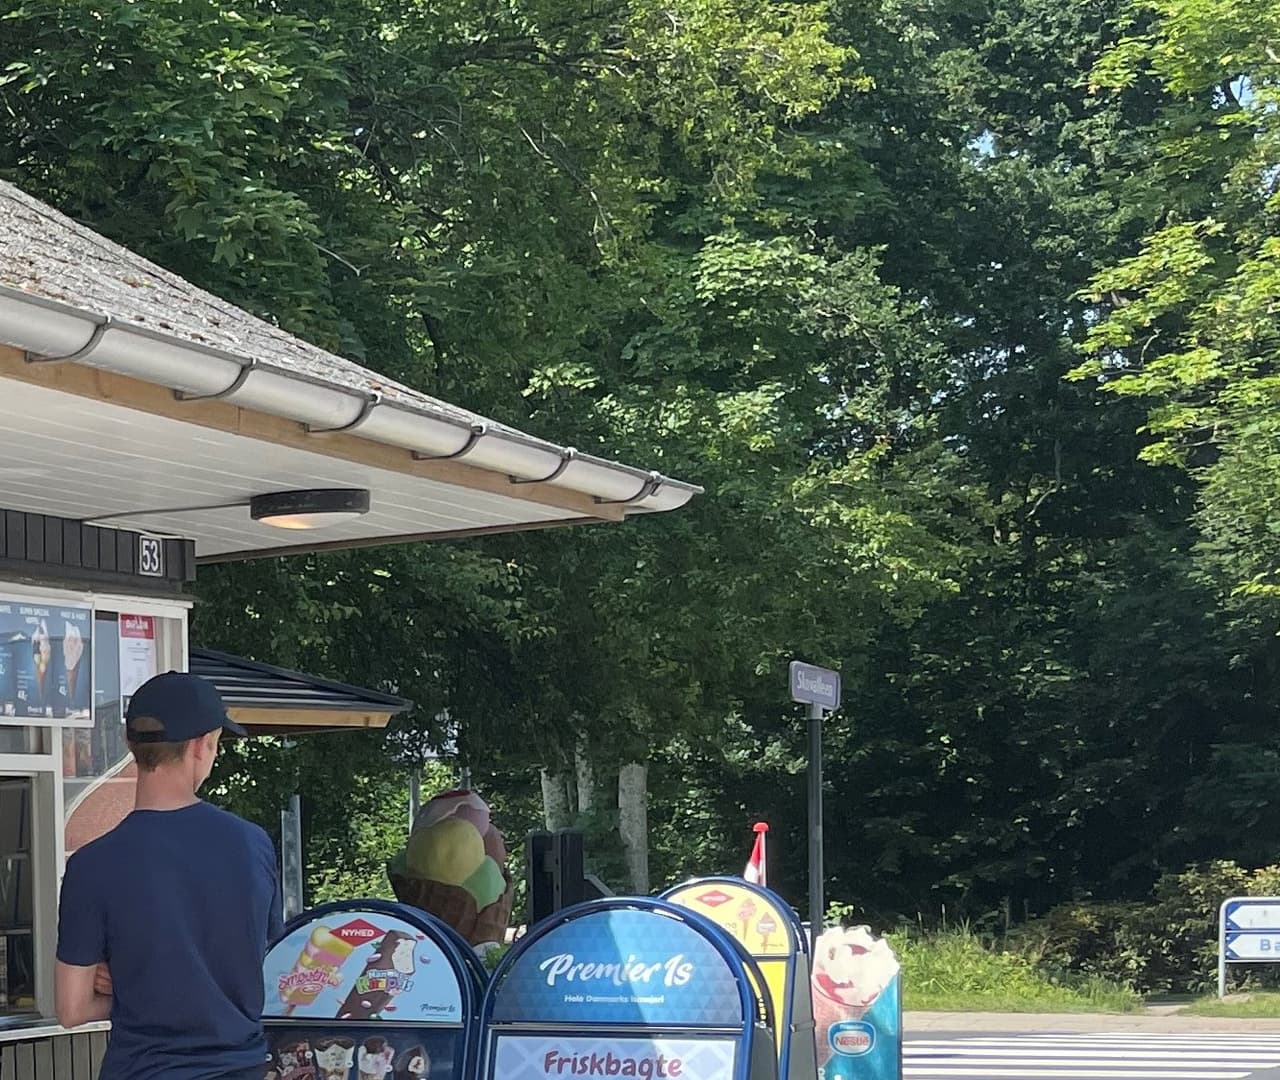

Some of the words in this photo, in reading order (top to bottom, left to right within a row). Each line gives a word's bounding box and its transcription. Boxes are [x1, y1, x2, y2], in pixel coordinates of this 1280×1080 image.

[142, 540, 159, 572] 53
[341, 928, 374, 938] NYHED
[540, 954, 661, 986] Premier
[664, 954, 693, 987] Is
